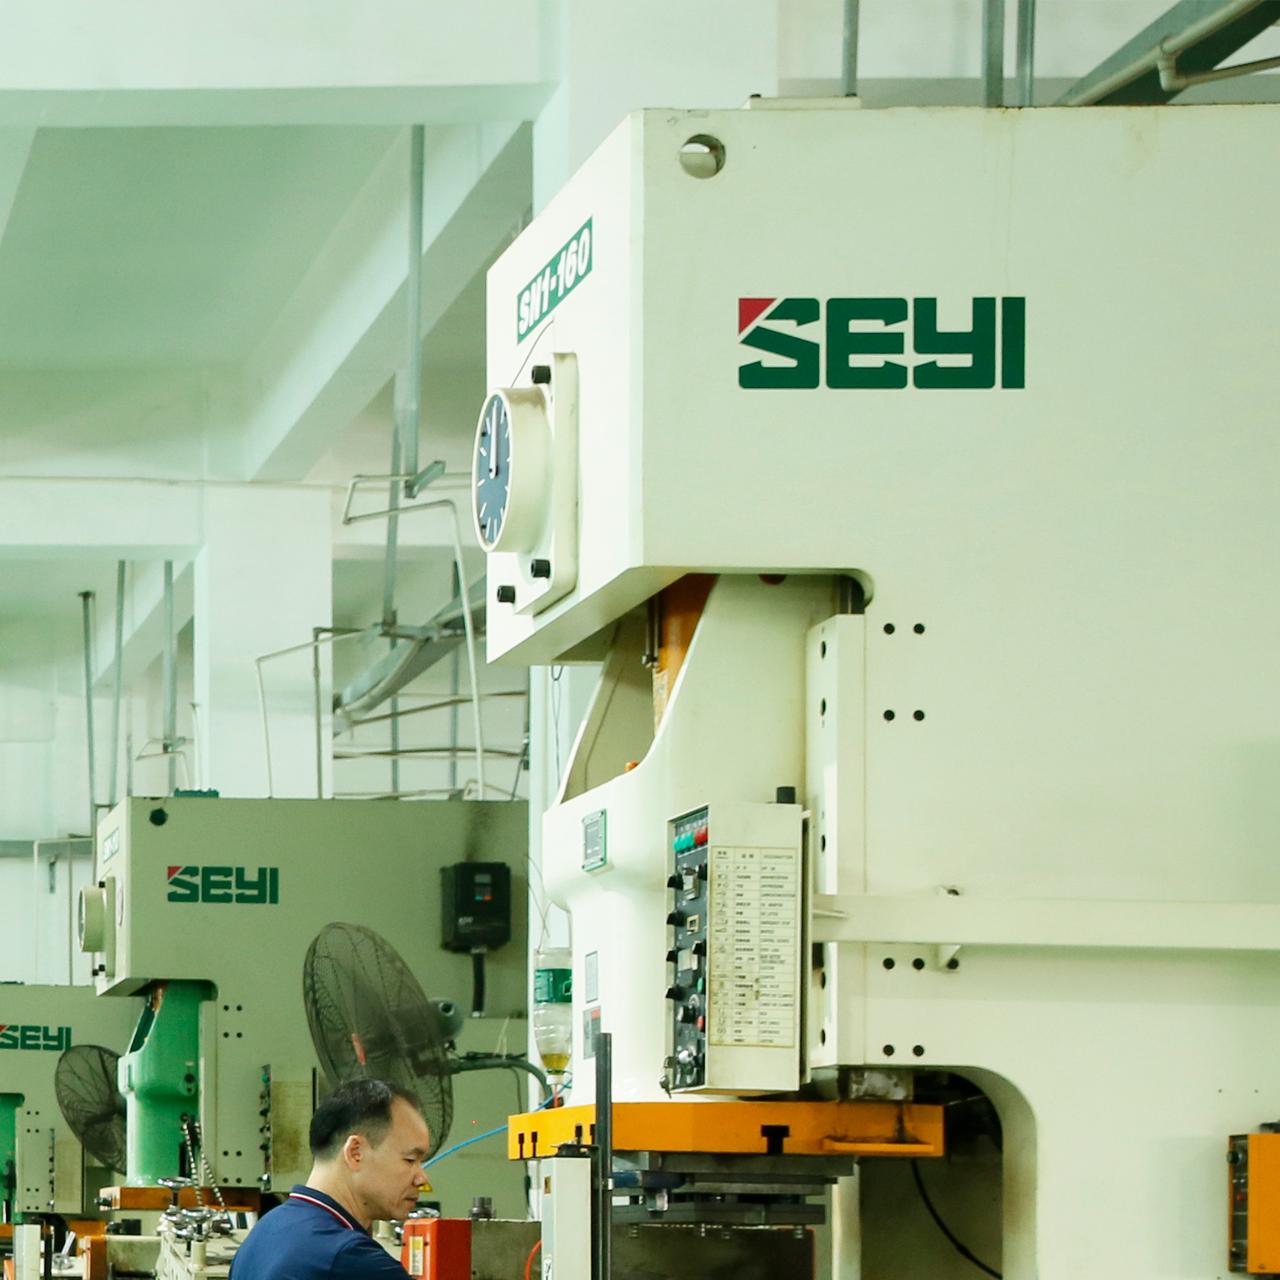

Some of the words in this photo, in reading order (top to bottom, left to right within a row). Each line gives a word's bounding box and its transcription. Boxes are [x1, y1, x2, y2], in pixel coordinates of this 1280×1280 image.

[519, 227, 591, 336] SN1-160
[738, 296, 1026, 390] SEYI
[167, 865, 279, 904] SEYI
